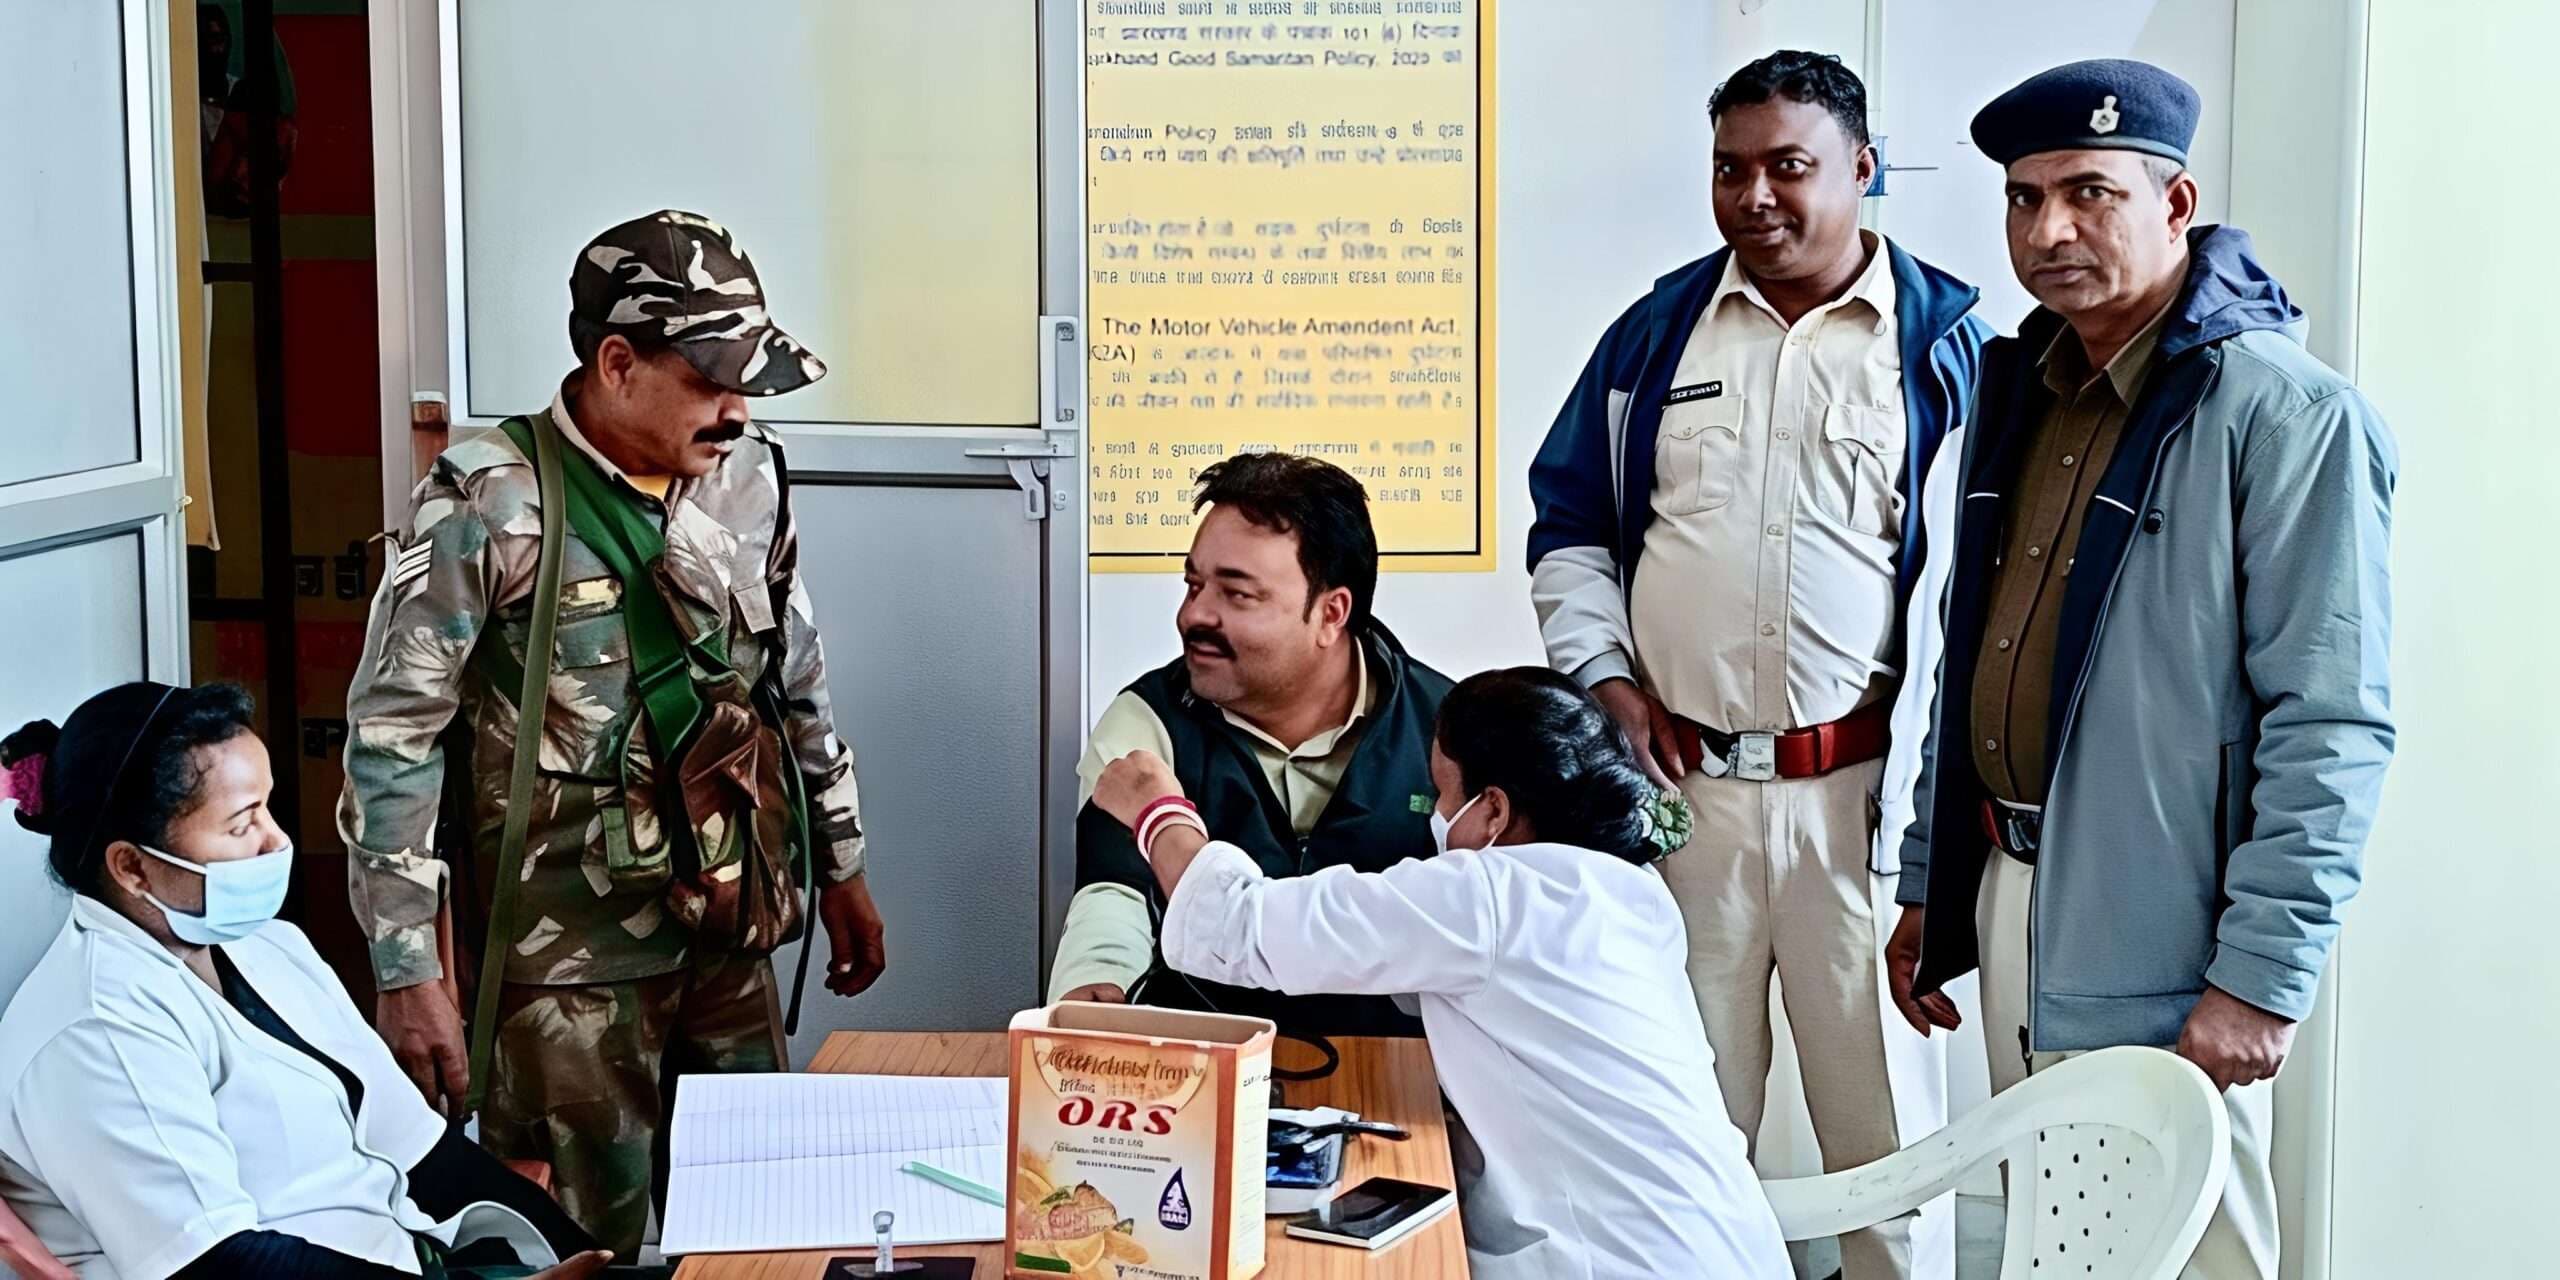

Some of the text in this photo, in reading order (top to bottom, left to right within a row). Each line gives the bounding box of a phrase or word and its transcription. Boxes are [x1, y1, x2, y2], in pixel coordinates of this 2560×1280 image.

[1169, 51, 1216, 66] Good
[1102, 317, 1142, 336] The
[1151, 317, 1210, 337] Motor
[1219, 317, 1298, 337] Vehicle
[1304, 317, 1414, 336] Amendent
[1058, 1097, 1178, 1136] ORS
